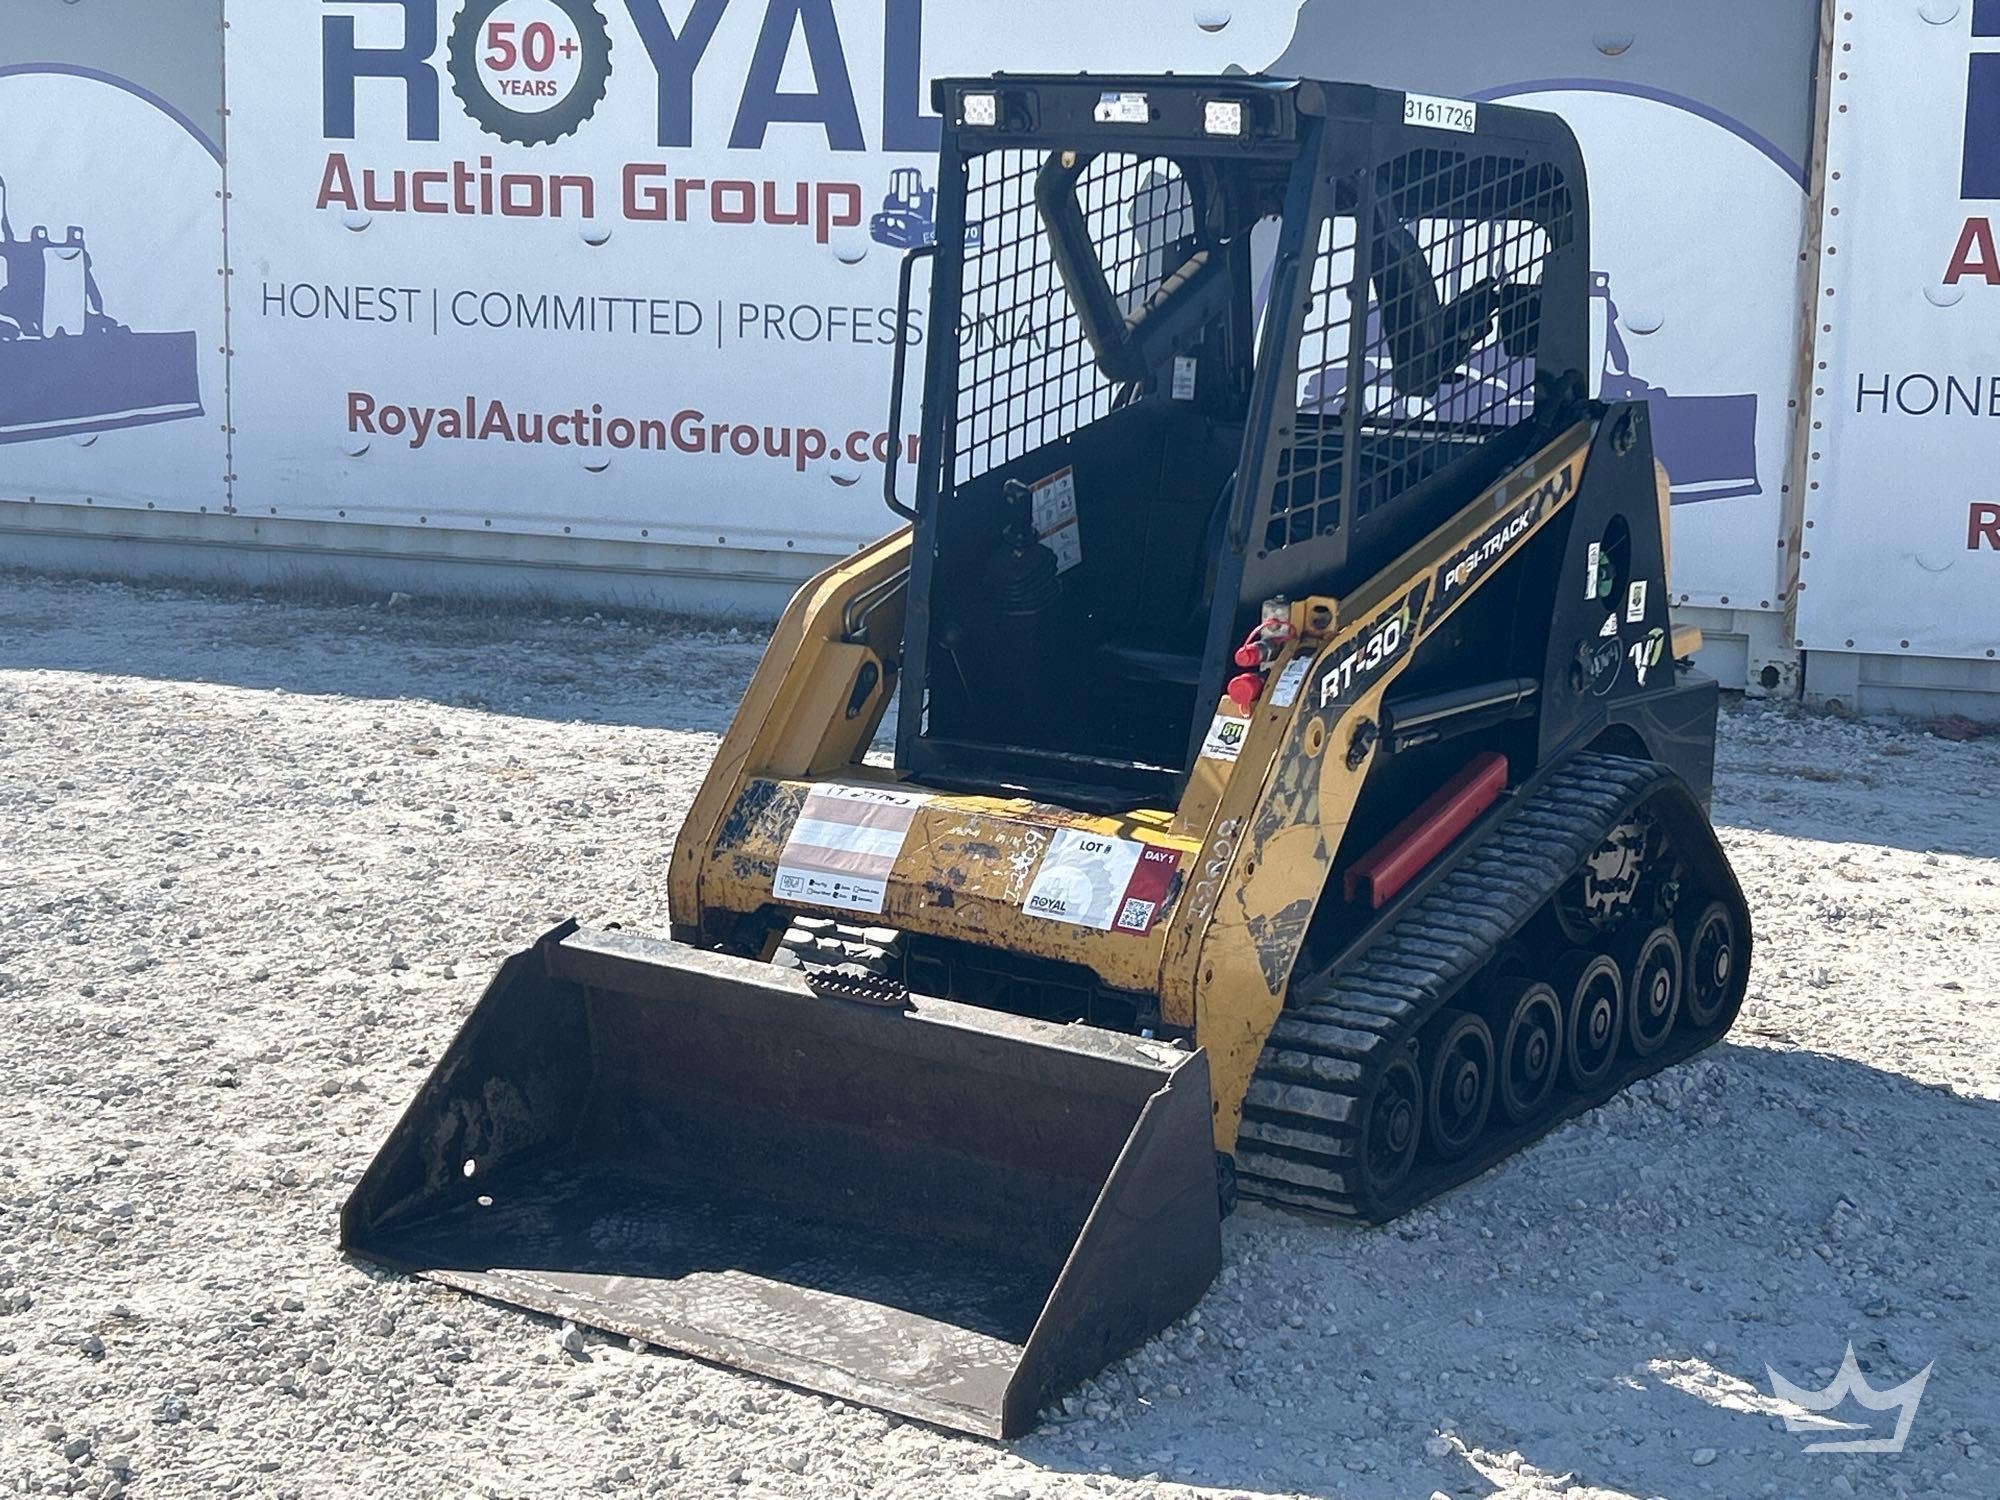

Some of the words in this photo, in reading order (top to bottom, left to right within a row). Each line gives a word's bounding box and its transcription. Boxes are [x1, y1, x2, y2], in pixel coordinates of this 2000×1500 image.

[485, 22, 578, 72] 50+
[498, 80, 557, 96] YEARS
[1405, 100, 1473, 127] 3161726
[316, 153, 594, 218] Auction
[623, 163, 861, 244] Group
[262, 282, 421, 322] HONEST
[451, 290, 703, 335] COMMITTED
[1319, 618, 1401, 708] RT-30
[1079, 840, 1103, 853] LOT
[1144, 850, 1168, 863] DAY
[1168, 854, 1175, 864] 1
[1029, 895, 1067, 911] ROYAL
